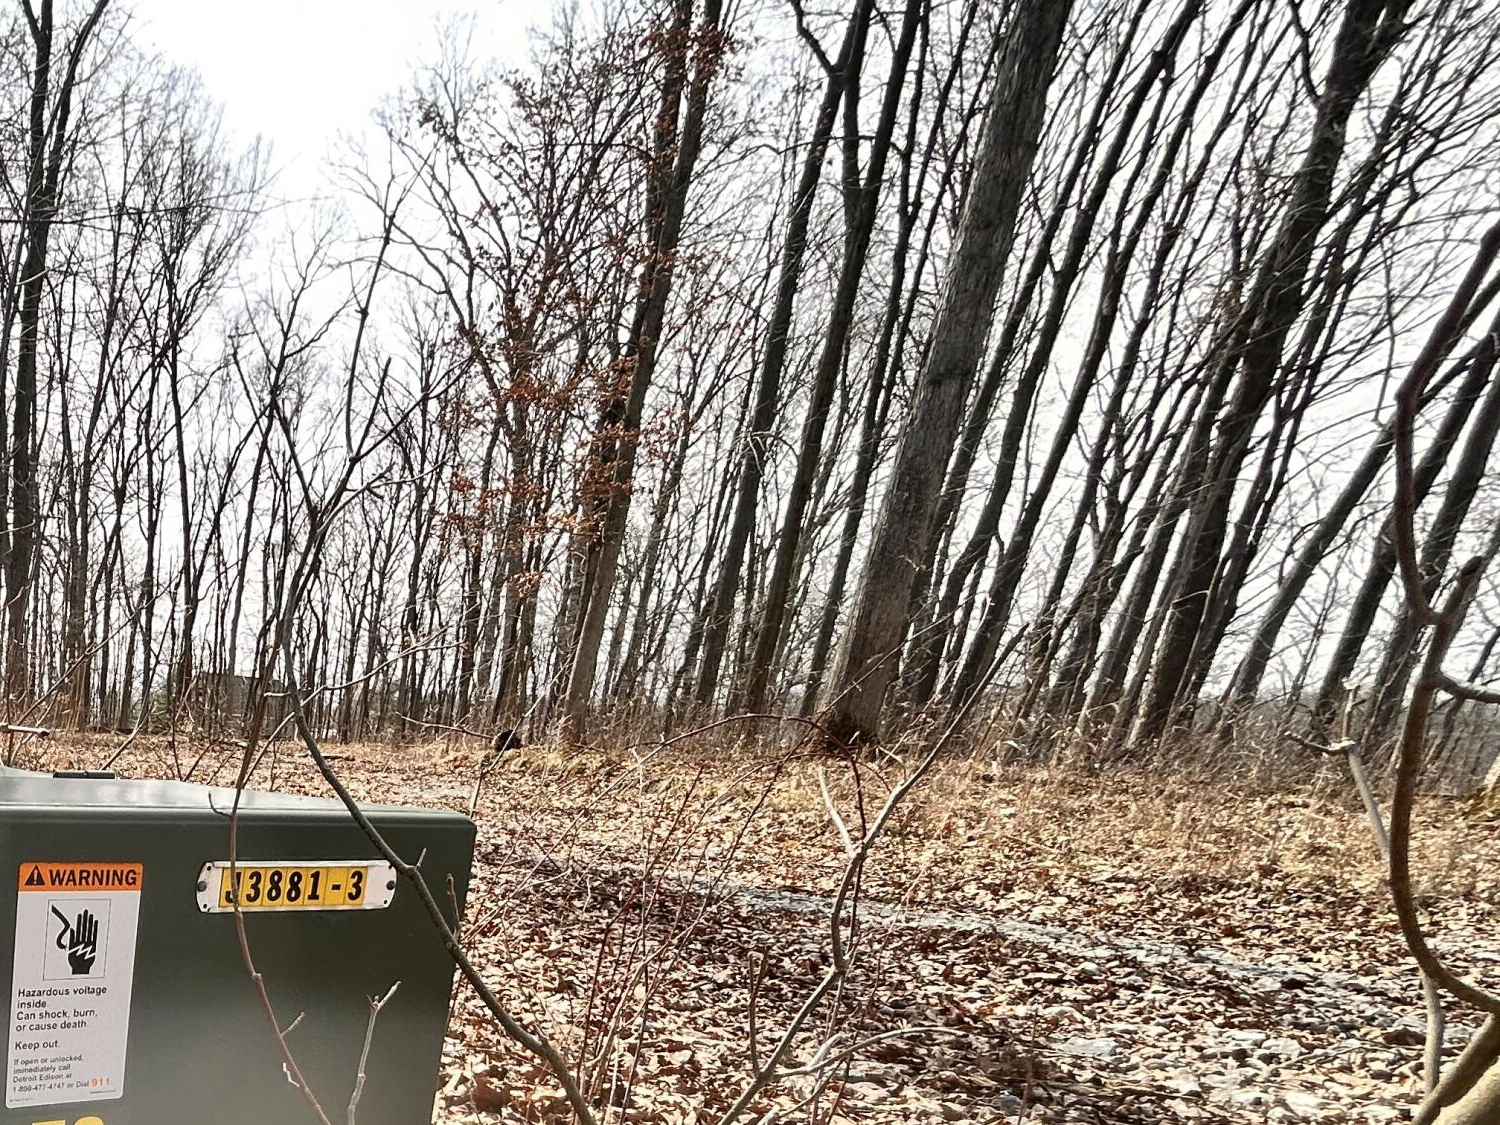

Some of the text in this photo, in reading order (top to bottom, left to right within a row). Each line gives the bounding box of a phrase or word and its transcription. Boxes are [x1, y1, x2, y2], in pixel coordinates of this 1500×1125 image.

[48, 868, 137, 886] WARNING
[18, 986, 107, 998] Hazardous voltage
[16, 1009, 98, 1021] Can shock, burn,
[15, 1024, 26, 1032] or
[29, 1022, 58, 1031] cause
[15, 1040, 40, 1051] Keep
[13, 1065, 56, 1074] immediately
[13, 1075, 37, 1083] Detroit
[39, 1073, 64, 1081] Edison
[76, 1080, 90, 1088] Dial
[91, 1077, 110, 1087] 911
